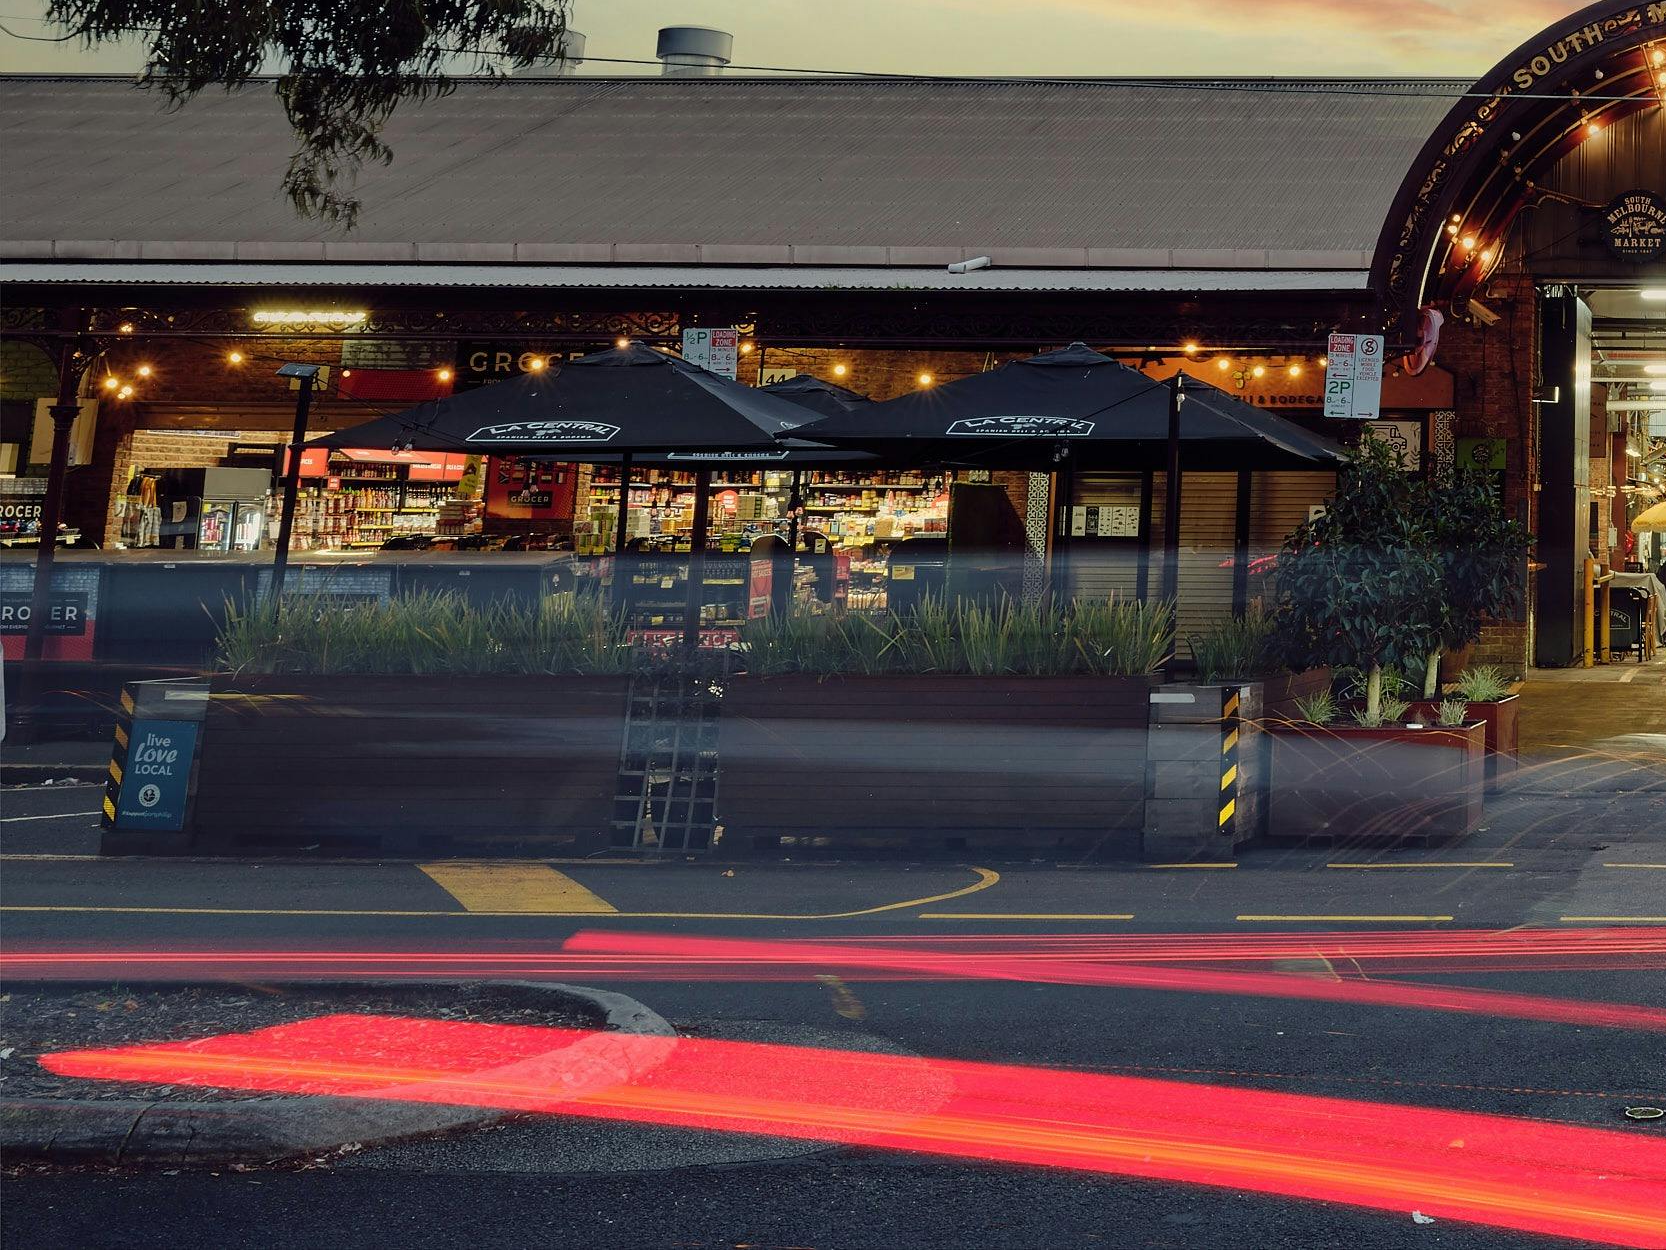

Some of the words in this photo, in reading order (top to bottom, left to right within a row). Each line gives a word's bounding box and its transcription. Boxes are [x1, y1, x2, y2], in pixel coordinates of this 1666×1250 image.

[1513, 24, 1604, 90] SOUTH
[1624, 196, 1651, 205] SOUTH
[1614, 238, 1662, 247] MARKET
[712, 330, 737, 338] LOADING
[715, 338, 734, 347] ZONE
[1331, 335, 1354, 344] LOADING
[1333, 344, 1351, 352] ZONE
[1328, 381, 1351, 394] 2P
[1270, 395, 1324, 405] BODEGA
[490, 424, 523, 434] LA
[526, 421, 611, 434] CENTRAL
[965, 419, 997, 427] LA
[510, 495, 549, 503] GROCER
[2, 606, 77, 620] ROER
[146, 732, 172, 747] live
[134, 763, 173, 776] LOCAL
